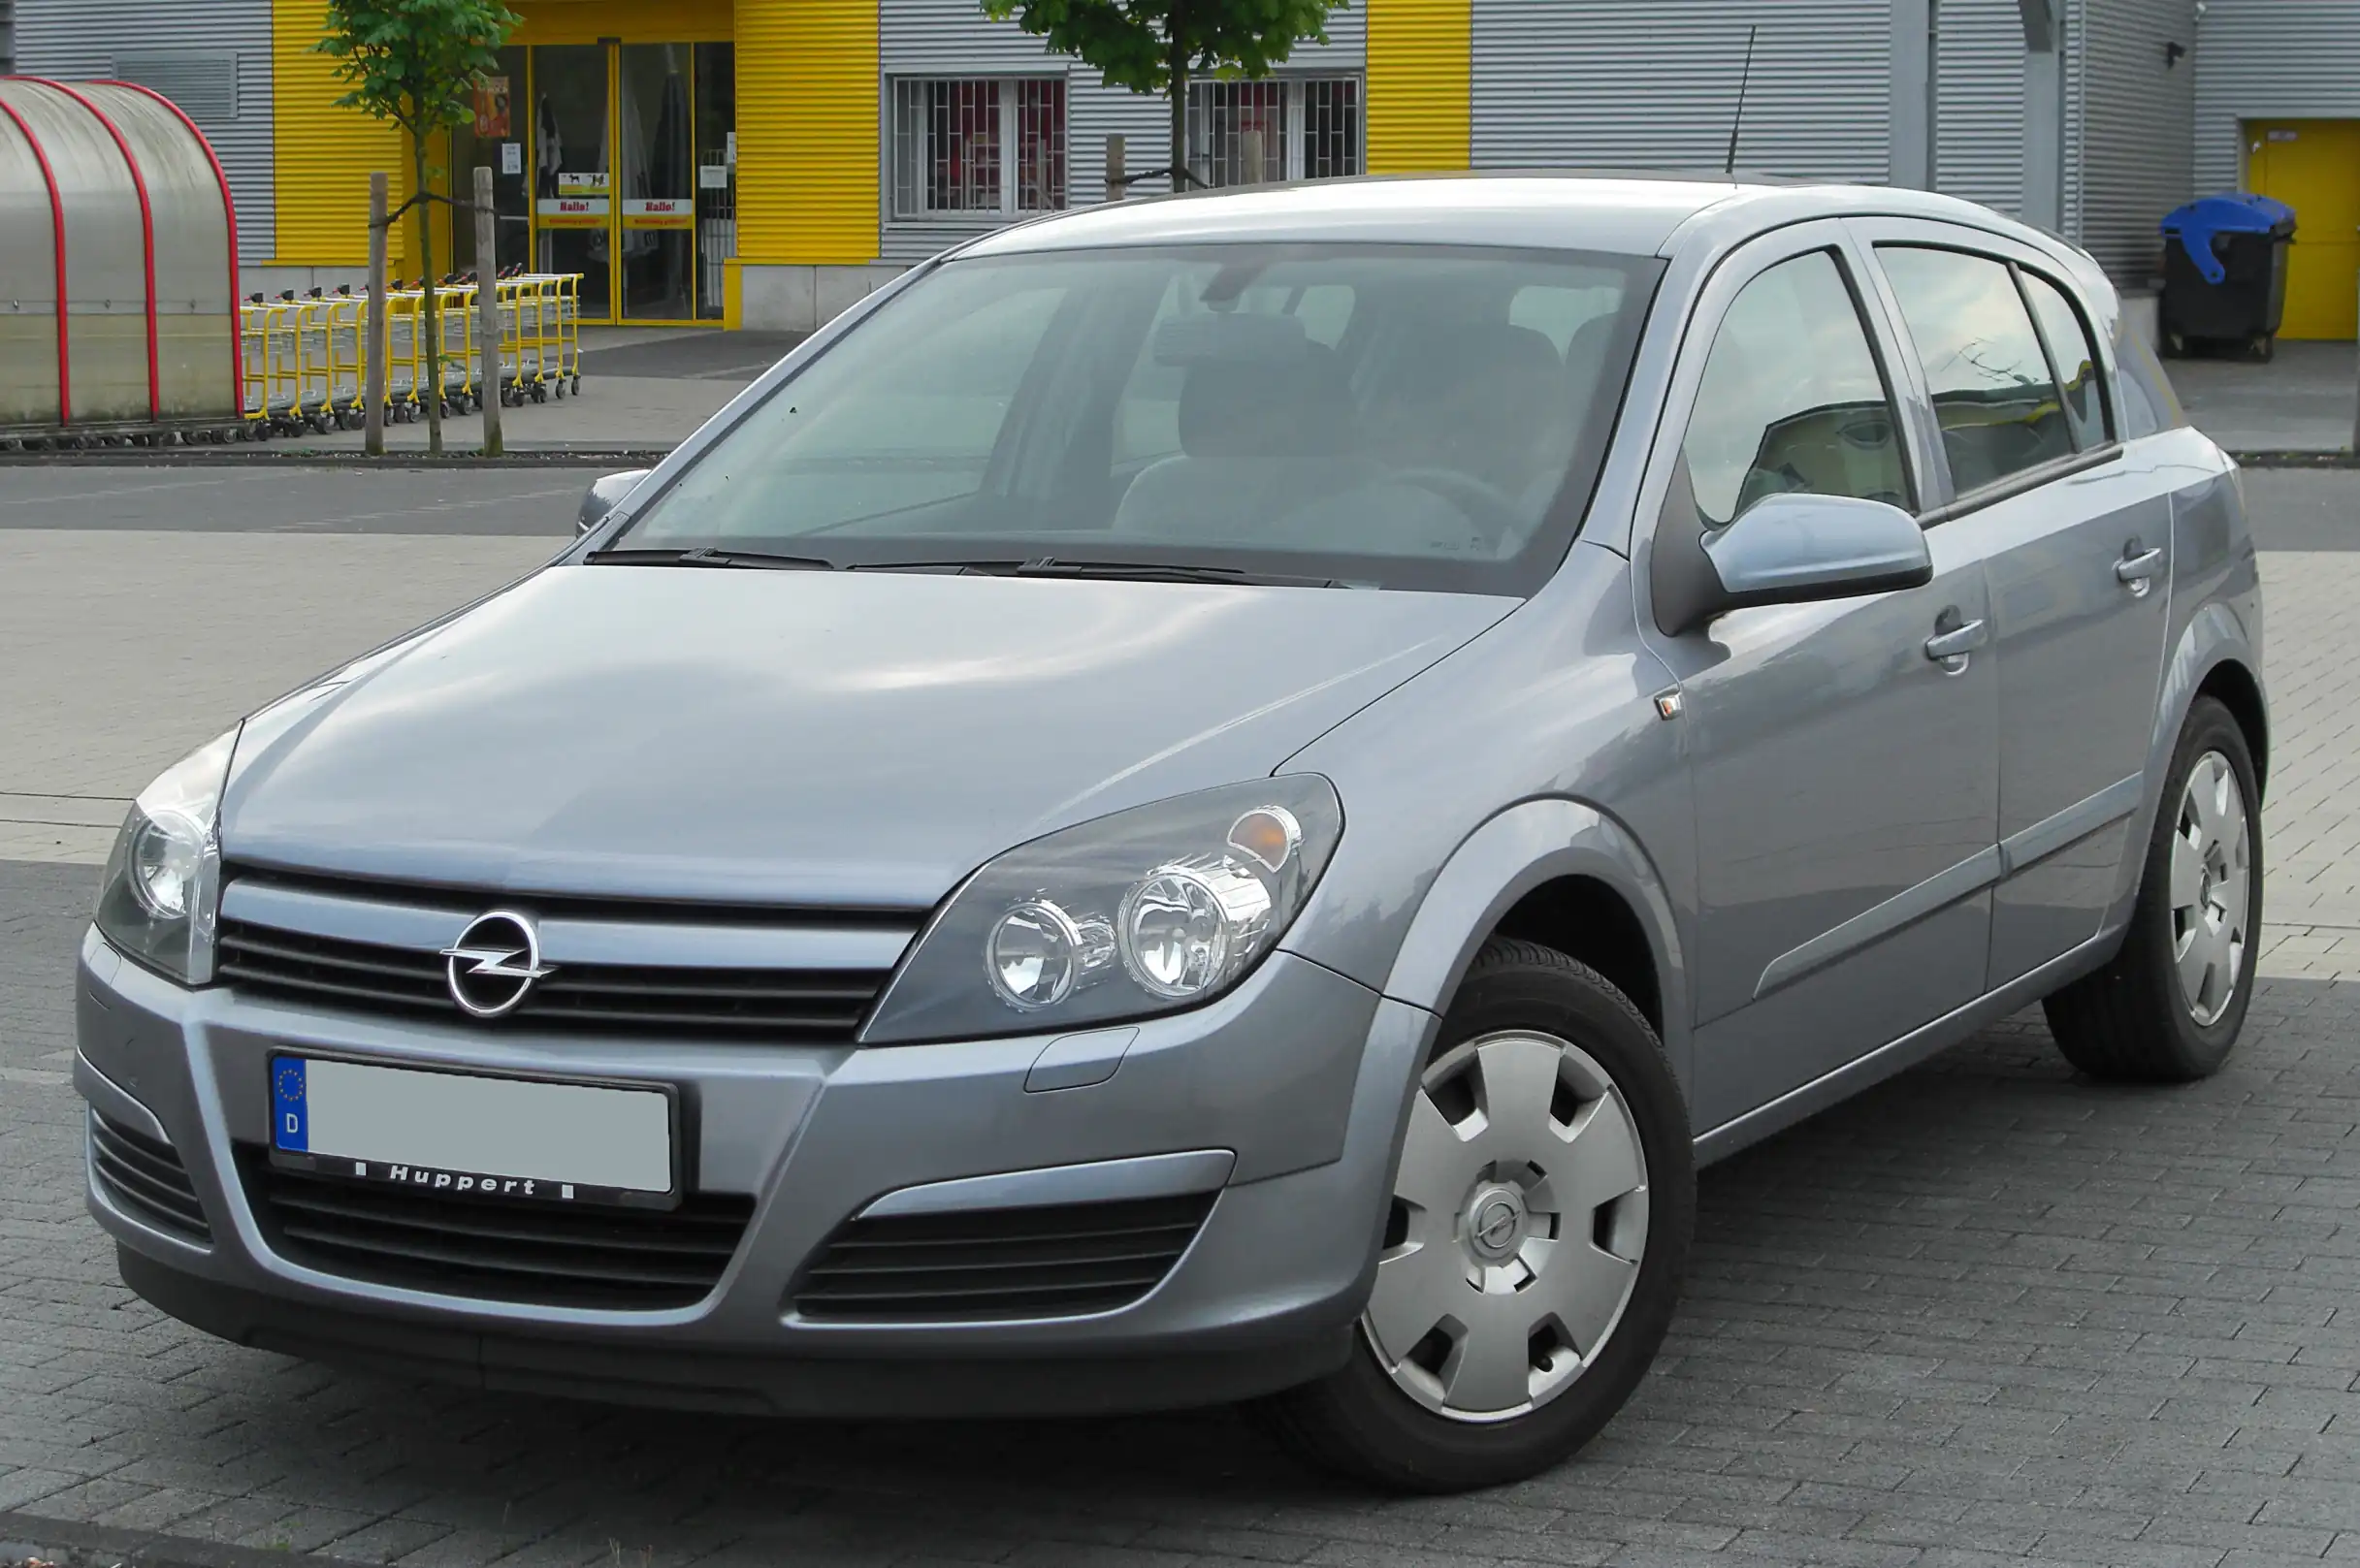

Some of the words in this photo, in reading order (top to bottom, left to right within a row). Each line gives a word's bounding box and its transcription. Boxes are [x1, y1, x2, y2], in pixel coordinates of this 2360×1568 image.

[560, 201, 590, 211] Hallo!
[645, 201, 676, 211] Hallo!
[286, 1113, 299, 1134] D
[390, 1165, 535, 1195] Huppert
